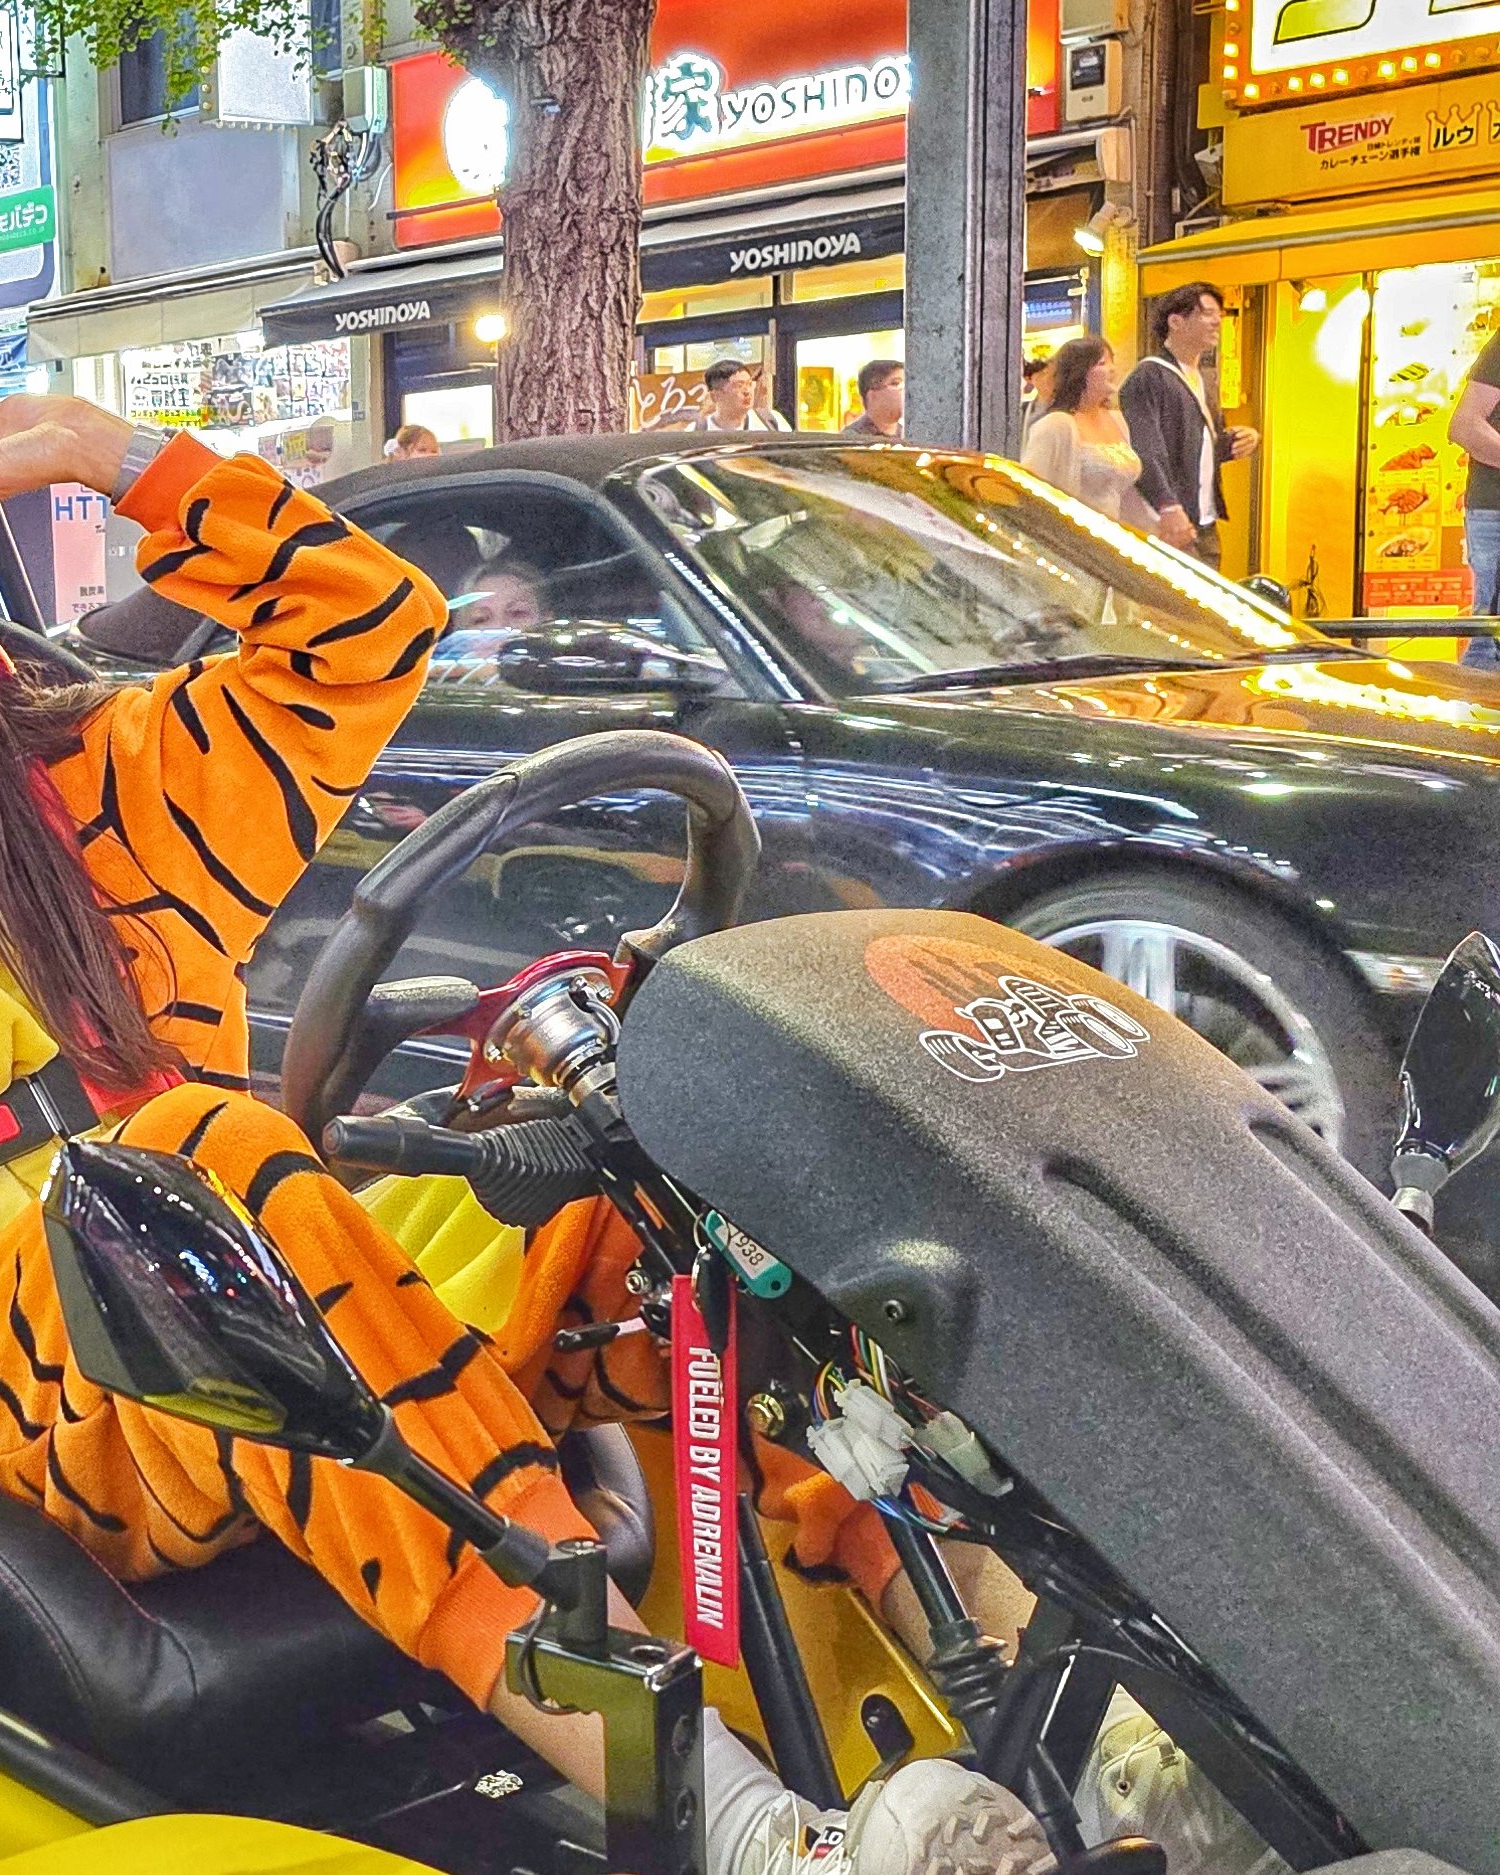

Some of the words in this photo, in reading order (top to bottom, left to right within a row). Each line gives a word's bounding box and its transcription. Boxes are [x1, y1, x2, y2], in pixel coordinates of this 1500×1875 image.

[727, 65, 910, 130] YOSHINO
[1300, 117, 1394, 154] TRENDY
[1433, 125, 1474, 149] ルウ
[1320, 146, 1421, 170] カレーチェーン選手権
[729, 232, 862, 273] YOSHINOYA
[335, 300, 431, 332] YOSHINOYA
[688, 1346, 723, 1441] FUELED
[689, 1445, 722, 1483] BY
[691, 1484, 724, 1630] ADRENALIN
